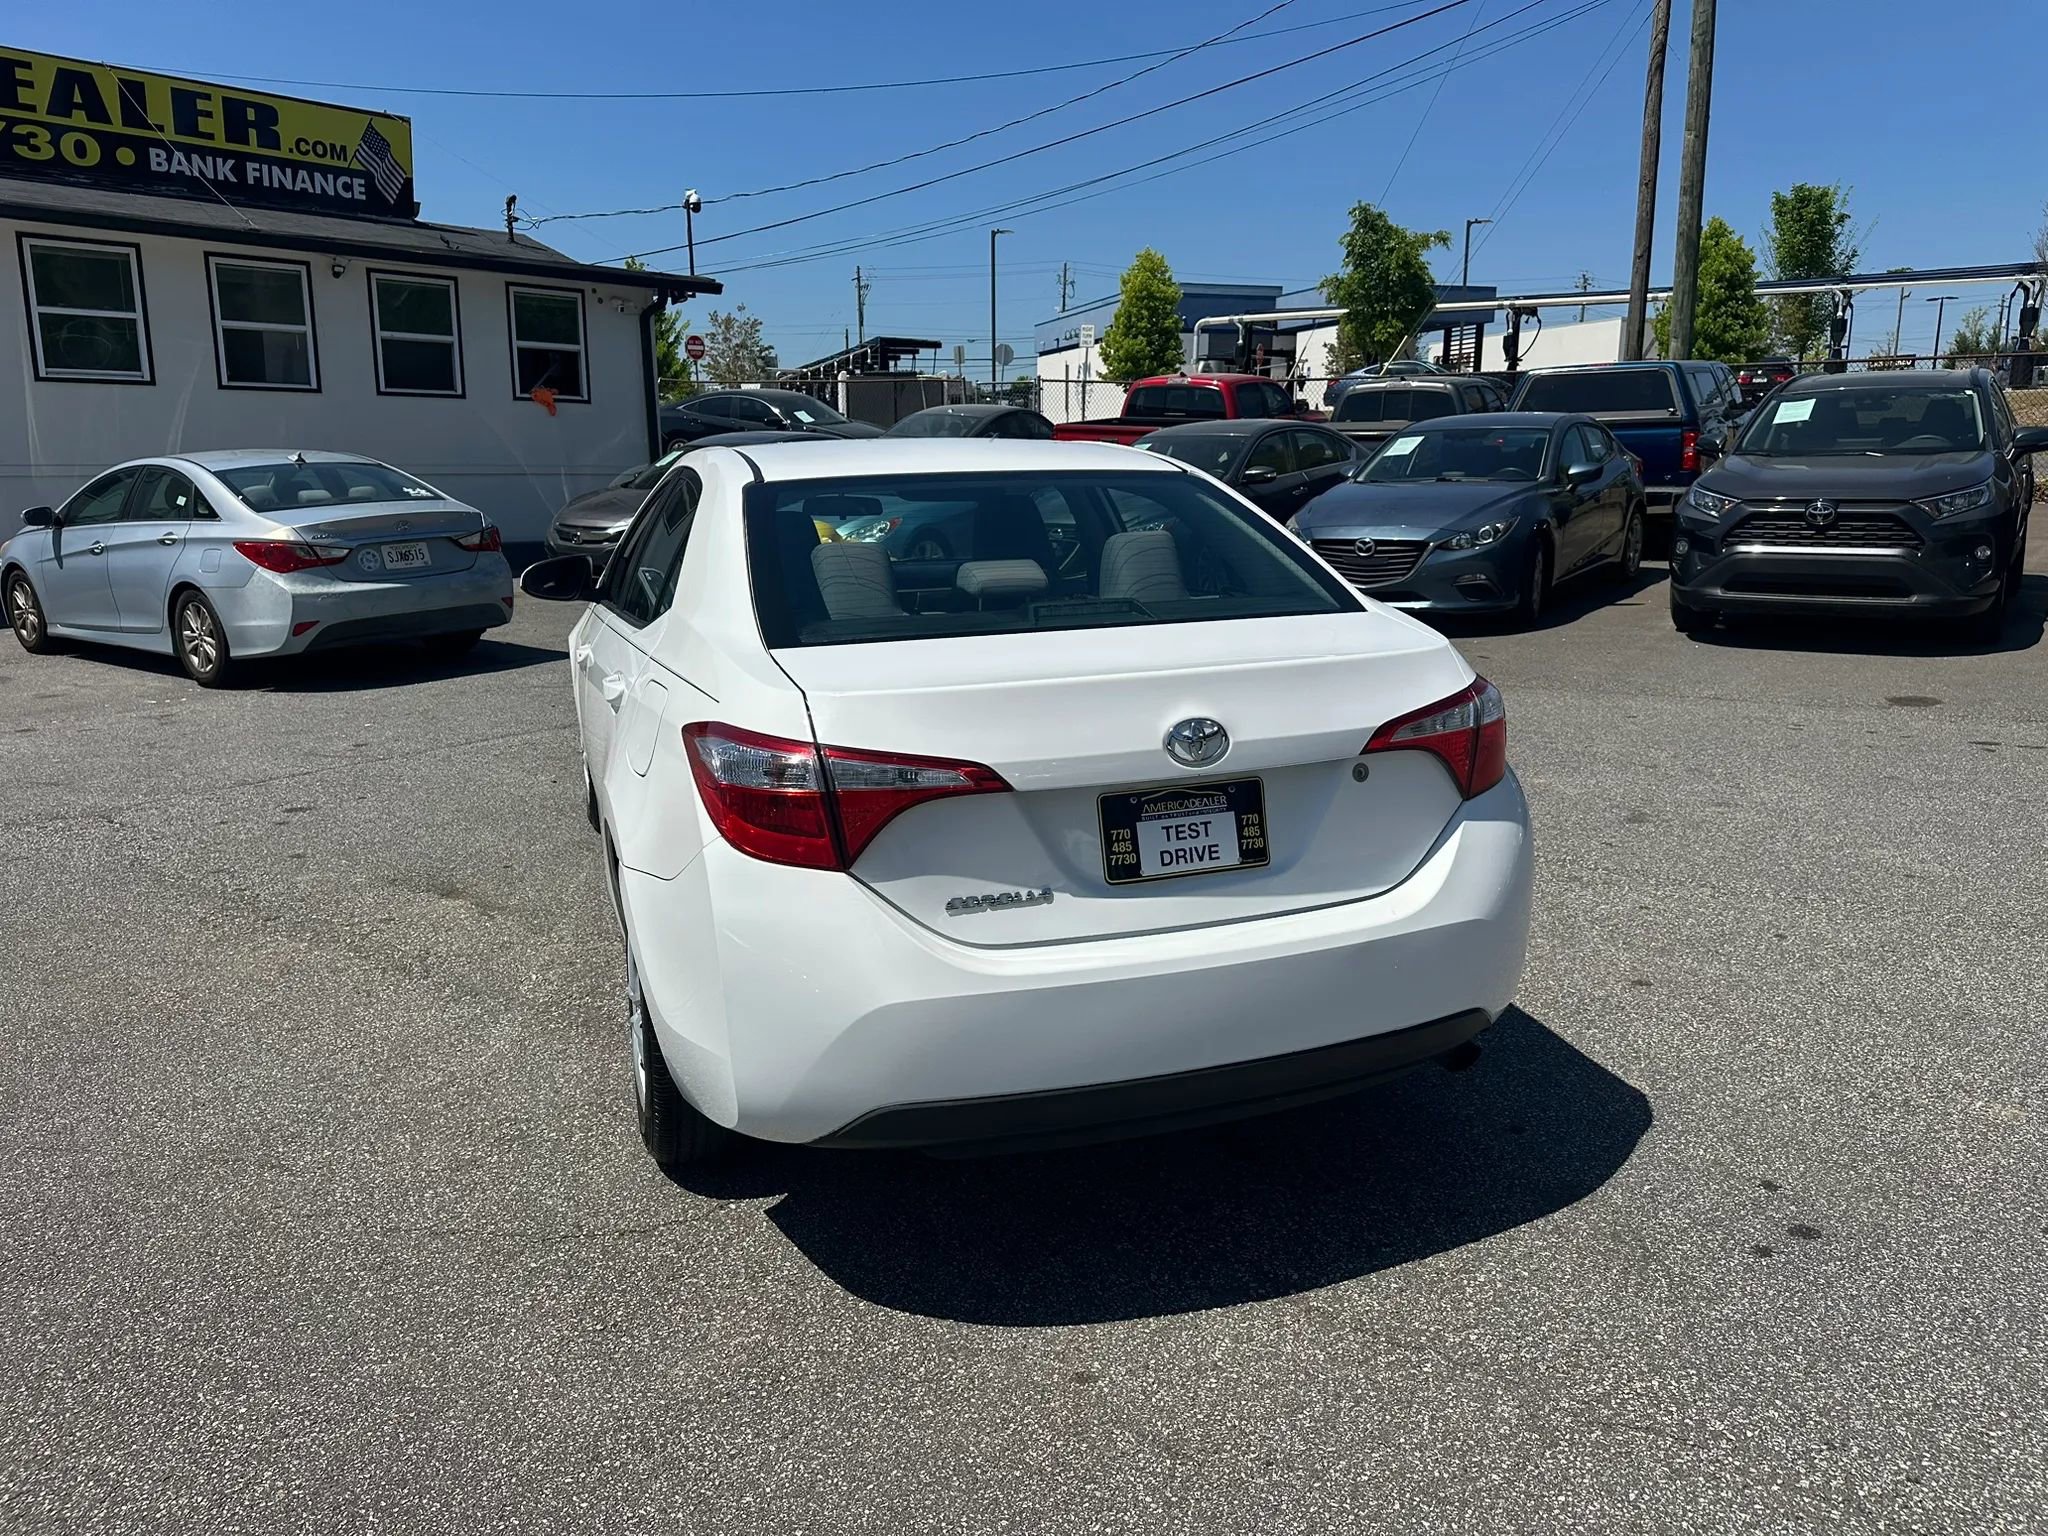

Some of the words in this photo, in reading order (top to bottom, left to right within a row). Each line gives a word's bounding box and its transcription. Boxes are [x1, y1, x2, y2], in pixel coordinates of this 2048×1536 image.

[0, 56, 281, 152] EALER
[0, 121, 101, 167] 30
[149, 147, 238, 183] BANK
[246, 161, 367, 200] FINANCE
[1142, 795, 1228, 813] AMERICADEALER
[1241, 815, 1259, 825] 770
[1110, 829, 1131, 841] 770
[1161, 821, 1212, 842] TEST
[1242, 826, 1260, 837] 485
[1112, 841, 1132, 853] 485
[1241, 838, 1264, 850] 7730
[1109, 853, 1137, 866] 7730
[1159, 844, 1221, 867] DRIVE
